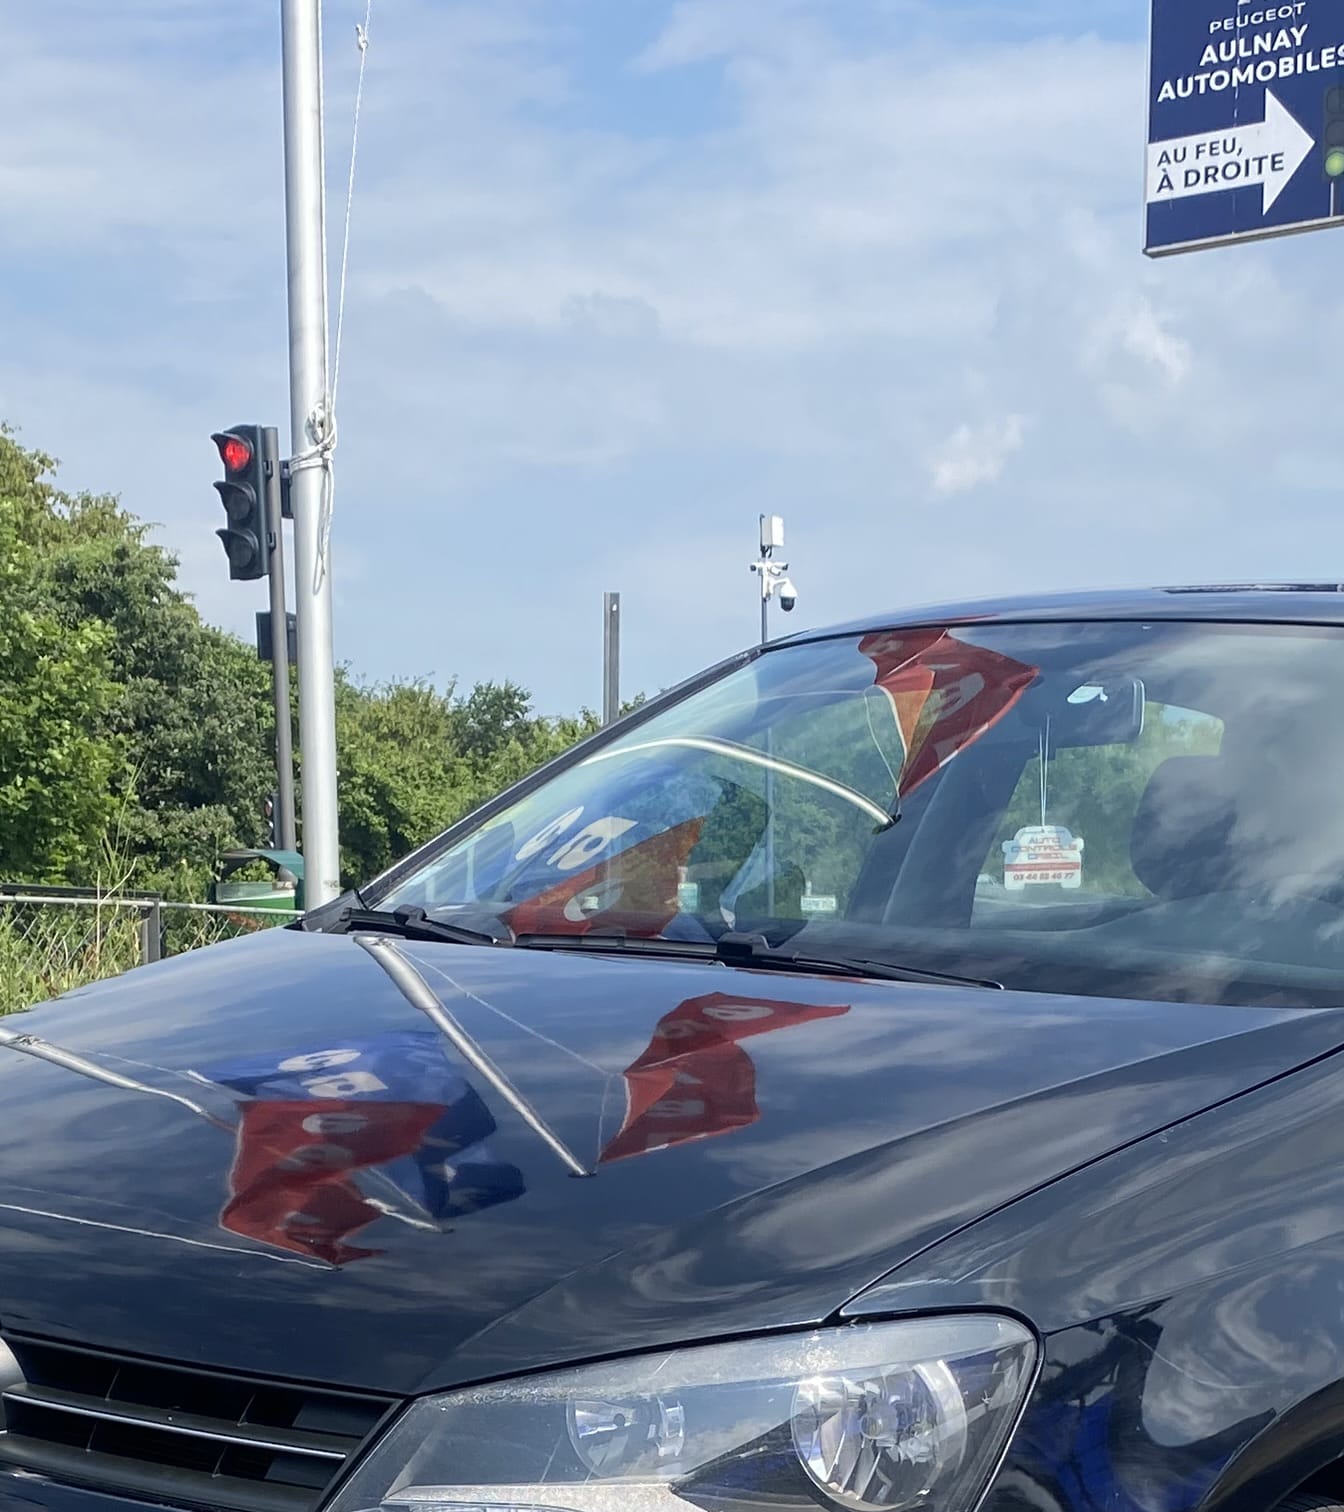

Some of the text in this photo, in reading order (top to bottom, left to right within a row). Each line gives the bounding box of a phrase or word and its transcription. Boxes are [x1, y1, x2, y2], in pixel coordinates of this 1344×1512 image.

[1209, 2, 1306, 34] PEUGEOT
[1199, 24, 1308, 66] AULNAY
[1156, 137, 1243, 167] AU FEU,
[1156, 152, 1285, 194] À DROITE
